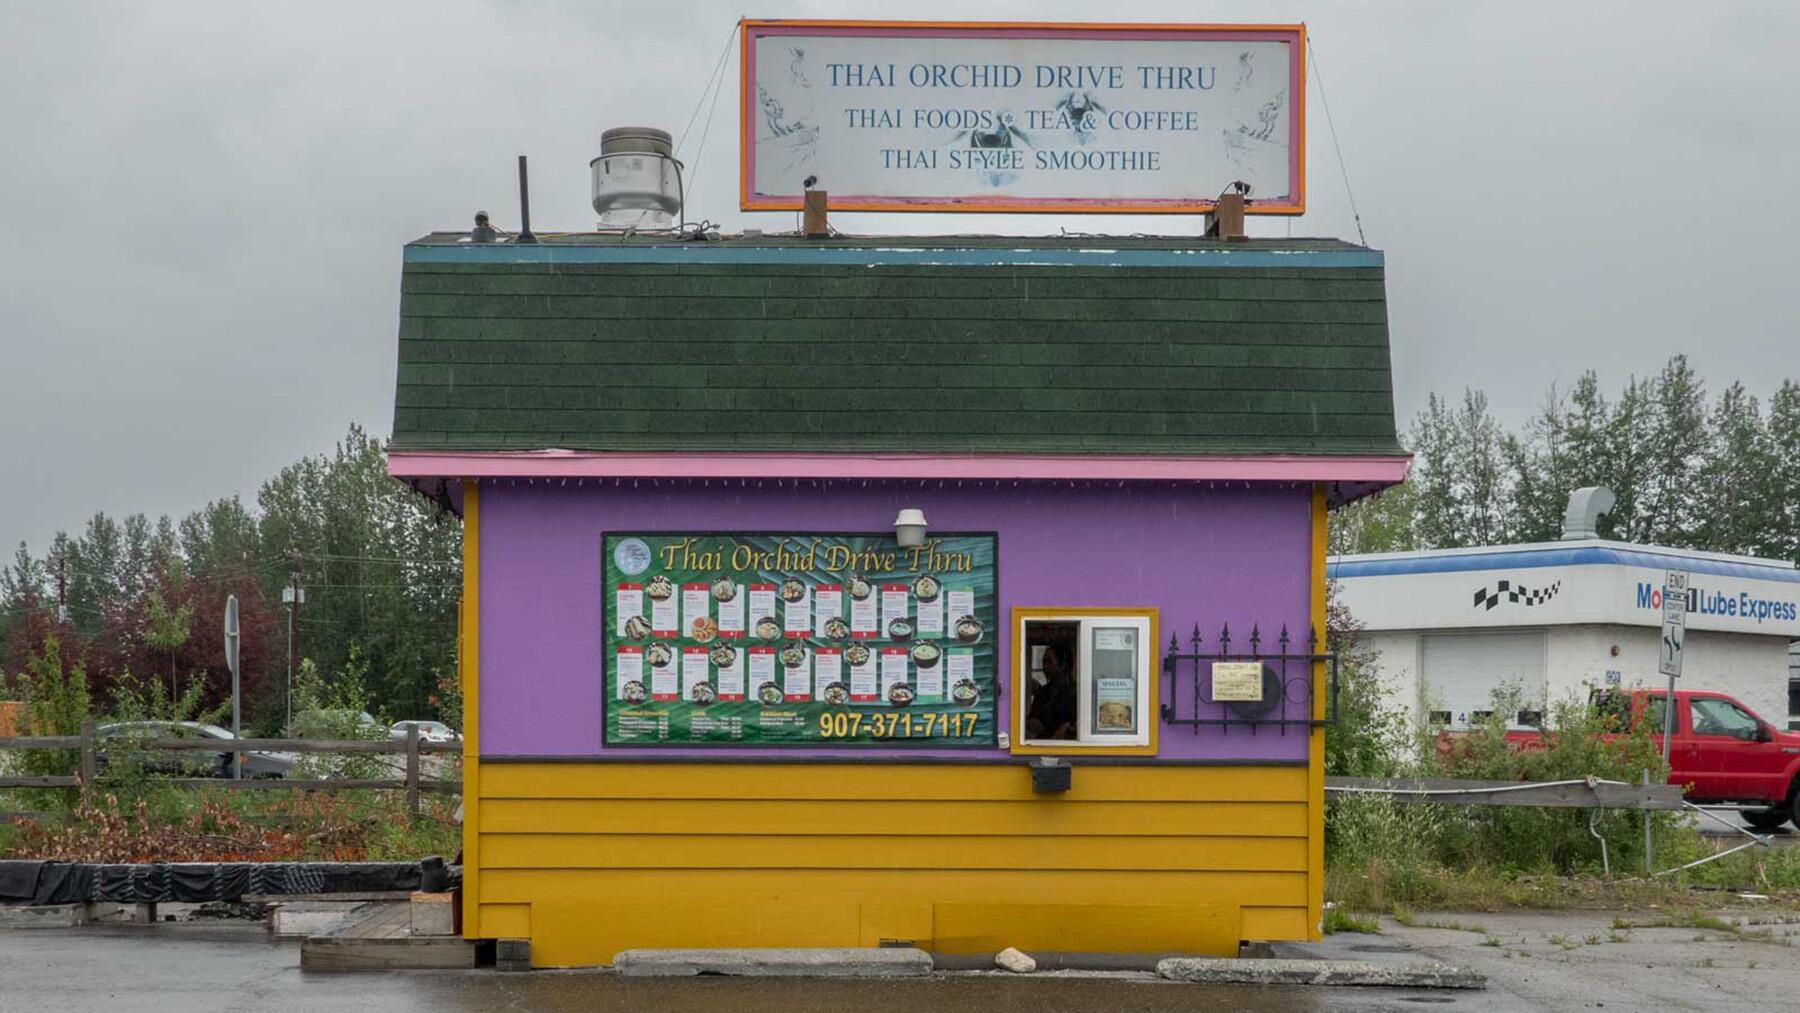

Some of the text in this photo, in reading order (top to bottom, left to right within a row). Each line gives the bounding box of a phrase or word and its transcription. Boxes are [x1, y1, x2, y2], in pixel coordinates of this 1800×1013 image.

[826, 64, 1216, 90] THAI ORCHID DRIVE THRU
[845, 109, 1199, 131] THAI FOODS TEA & COFFEE
[880, 149, 1160, 171] THAI STYLE SMOOTHIE
[660, 536, 724, 571] Thai
[732, 537, 822, 571] Orchid
[824, 544, 896, 572] Drive
[904, 538, 973, 572] Thru
[1669, 573, 1685, 590] END
[1700, 588, 1737, 616] Lube
[1740, 592, 1797, 624] Express
[820, 712, 978, 738] 907-371-7117
[1458, 712, 1466, 722] 4
